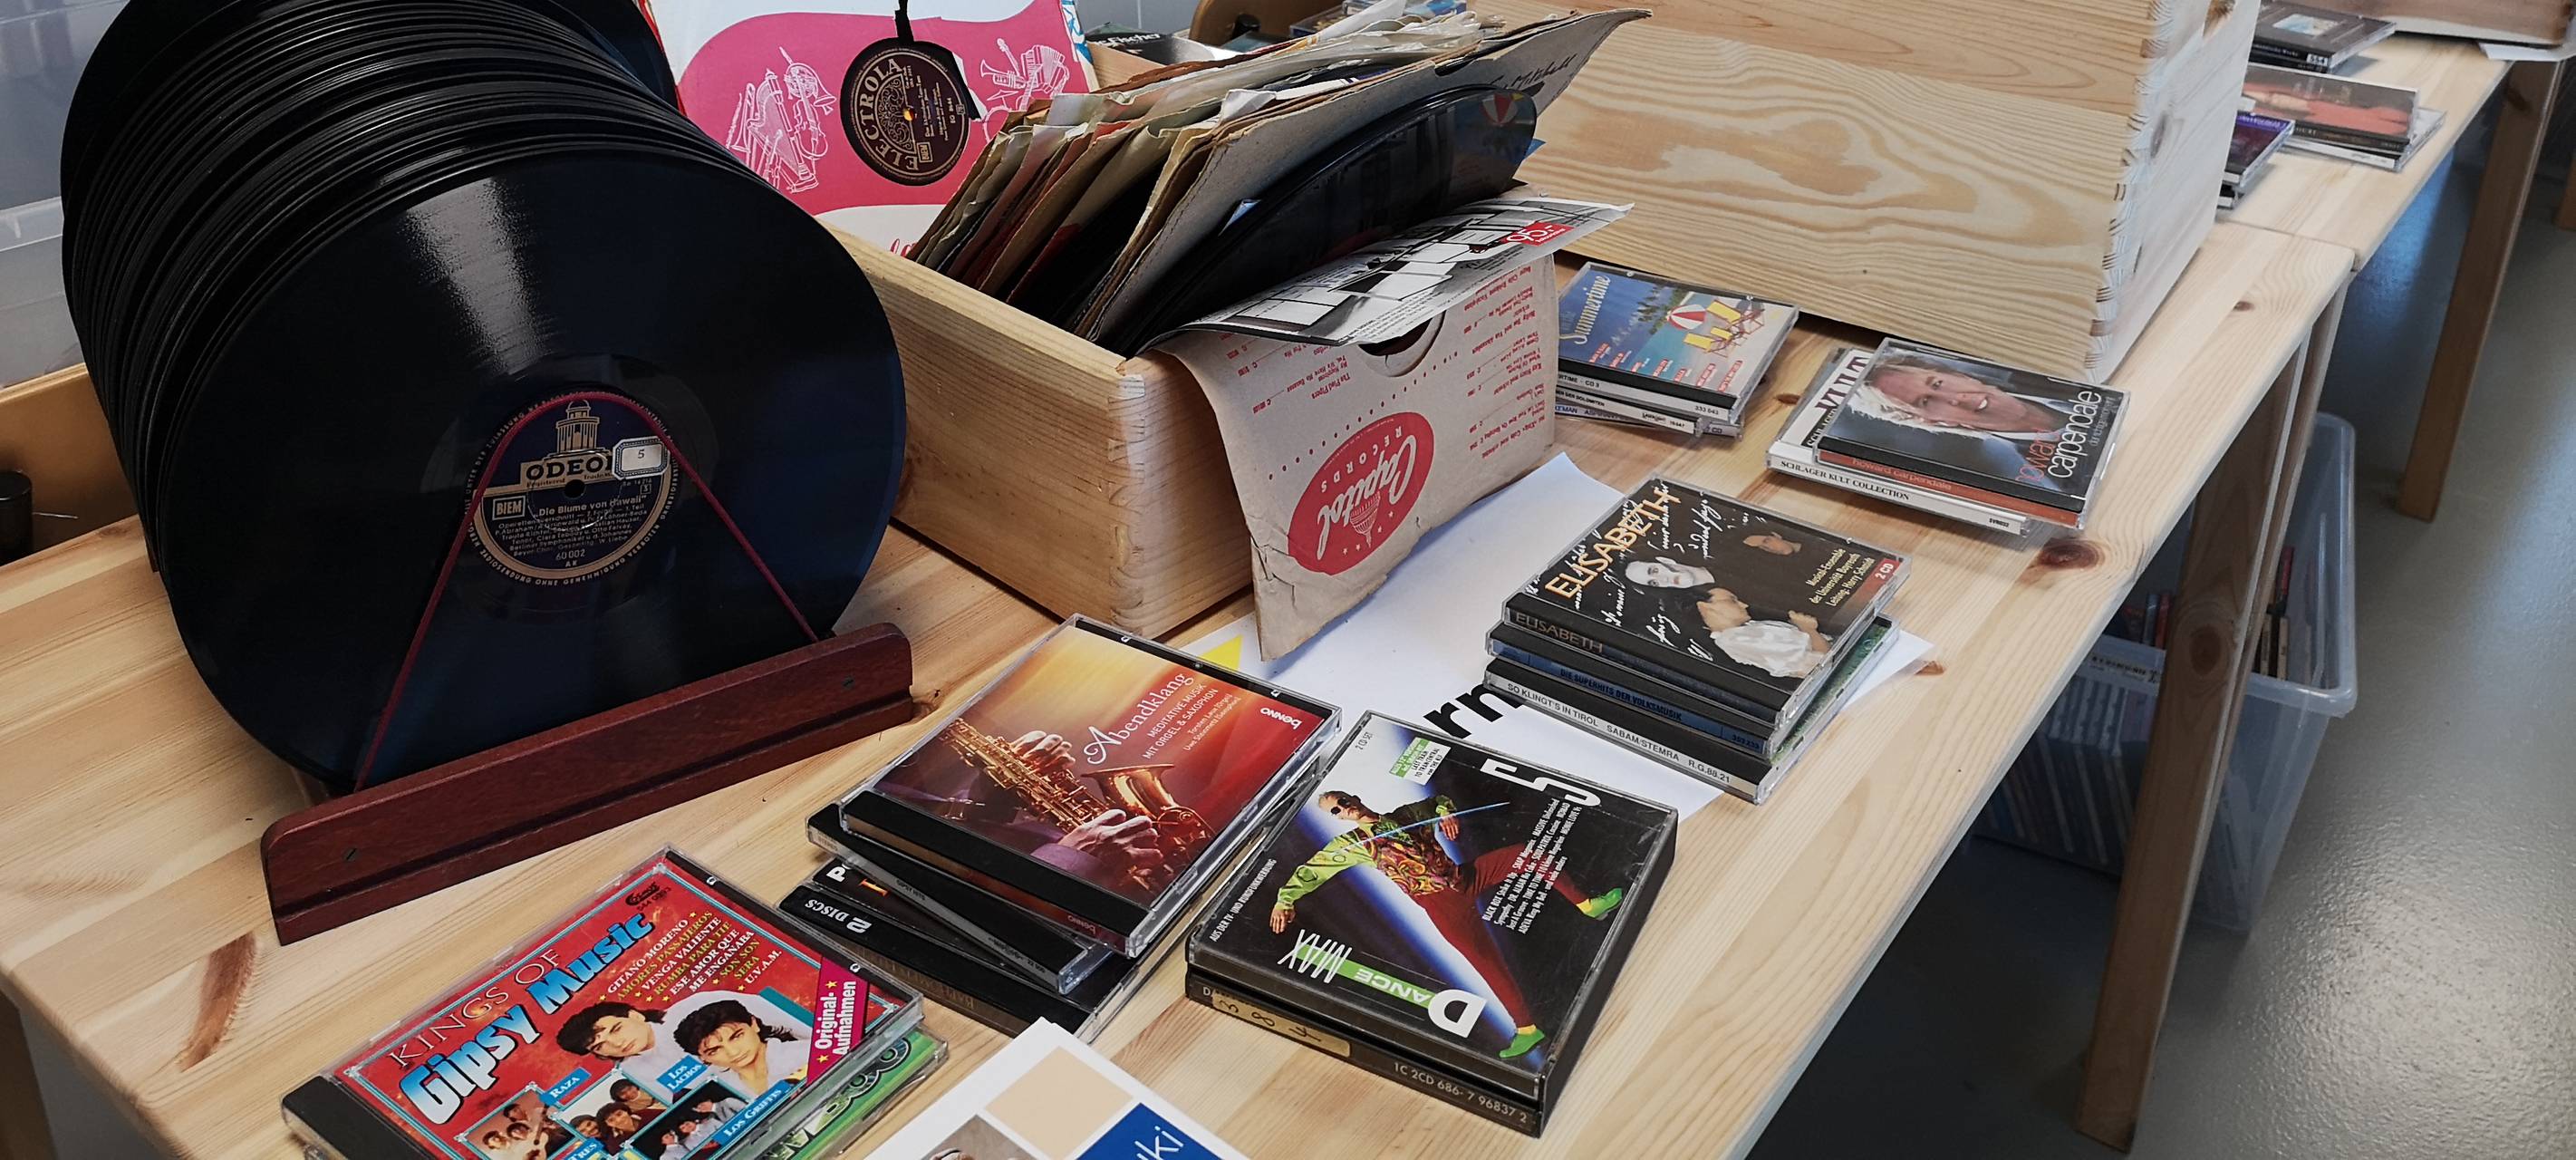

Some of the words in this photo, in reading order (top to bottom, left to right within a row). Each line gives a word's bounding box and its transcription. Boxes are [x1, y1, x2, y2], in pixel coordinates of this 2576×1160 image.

[860, 58, 920, 171] ELECTROLA
[1559, 276, 1611, 344] Summertime
[636, 449, 645, 459] 5
[2047, 390, 2102, 478] carpendale
[527, 456, 612, 480] ODEO
[1320, 425, 1403, 494] RECORDS
[1851, 456, 1893, 477] howard
[1892, 465, 1953, 491] carpendale
[1317, 434, 1417, 561] Capitol
[1780, 460, 1827, 478] SCHLAGER
[1828, 473, 1850, 486] KULT
[1851, 479, 1909, 500] COLLECTION
[495, 499, 522, 516] BIEM
[556, 502, 587, 515] Blume
[589, 500, 606, 509] von
[1545, 488, 1682, 599] ELISABETH
[1842, 573, 1861, 590] Harry
[1874, 570, 1886, 580] 2
[1879, 561, 1893, 575] CD
[1809, 593, 1821, 604] der
[1516, 613, 1604, 653] ELISABETH
[1148, 701, 1185, 738] MEDITATIVE
[1183, 682, 1205, 703] MUSIK
[1558, 667, 1575, 681] DIE
[1573, 672, 1615, 697] SUPERHITS
[1614, 688, 1632, 702] DER
[1631, 693, 1683, 723] VOLKSMUSIK
[1083, 672, 1194, 765] Abendklang
[1143, 744, 1159, 759] MIT
[1156, 724, 1179, 747] ORGEL
[1177, 718, 1186, 727] &
[1183, 687, 1217, 720] SAXOPHON
[1188, 716, 1207, 735] Torsten
[1259, 706, 1302, 730] benno
[1506, 682, 1521, 694] SO
[1559, 705, 1572, 716] IN
[1571, 710, 1599, 727] TIROL
[1606, 724, 1680, 761] SABAM/STEMRA
[1686, 759, 1731, 783] R.G.88.21
[1183, 739, 1196, 751] Uwe
[1481, 759, 1601, 807] 5
[1568, 810, 1579, 822] LOVE
[1482, 904, 1496, 921] BLACK
[1491, 894, 1502, 907] BOX
[1512, 856, 1524, 870] SNAP
[1532, 817, 1548, 836] MASSIVE
[1512, 877, 1527, 894] ALBAN
[1529, 881, 1538, 890] TO
[1531, 870, 1544, 884] TIME
[804, 898, 850, 922] DISCS
[1508, 891, 1519, 903] DR.
[1522, 886, 1535, 900] TIME
[845, 915, 872, 934] 2
[1067, 914, 1095, 935] benno
[1209, 928, 1222, 941] AUS
[1217, 919, 1230, 932] DER
[1224, 911, 1235, 922] TV-
[1230, 901, 1243, 914] UND
[607, 956, 646, 994] GITANO
[645, 918, 688, 960] MORENO
[617, 962, 656, 1000] AMORES
[658, 910, 710, 962] PASSAJEROS
[642, 958, 676, 991] VENGA
[676, 917, 719, 960] VALIENTE
[654, 962, 689, 995] RUMBA
[689, 936, 715, 962] PARA
[713, 921, 732, 939] TIE
[670, 975, 690, 995] ESE
[689, 949, 719, 977] AMOR
[717, 928, 739, 951] QUE
[719, 957, 740, 978] SON
[738, 938, 759, 959] SON
[733, 953, 759, 980] SERA
[744, 948, 781, 983] U.V.A.M.
[1278, 929, 1354, 984] MAX
[689, 974, 707, 992] ME
[388, 987, 509, 1069] KINGS
[513, 949, 563, 987] OF
[400, 1004, 542, 1125] Gipsy
[526, 912, 655, 1017] Music
[815, 991, 836, 1049] Original-
[833, 981, 856, 1056] Aufnahmen
[548, 1075, 581, 1098] RAZA
[1391, 1060, 1410, 1077] 1C
[1410, 1067, 1436, 1086] 2CD
[1435, 1077, 1465, 1098] 686-
[1464, 1089, 1476, 1102] 7
[1476, 1093, 1516, 1119] 96837
[1517, 1111, 1529, 1124] 2
